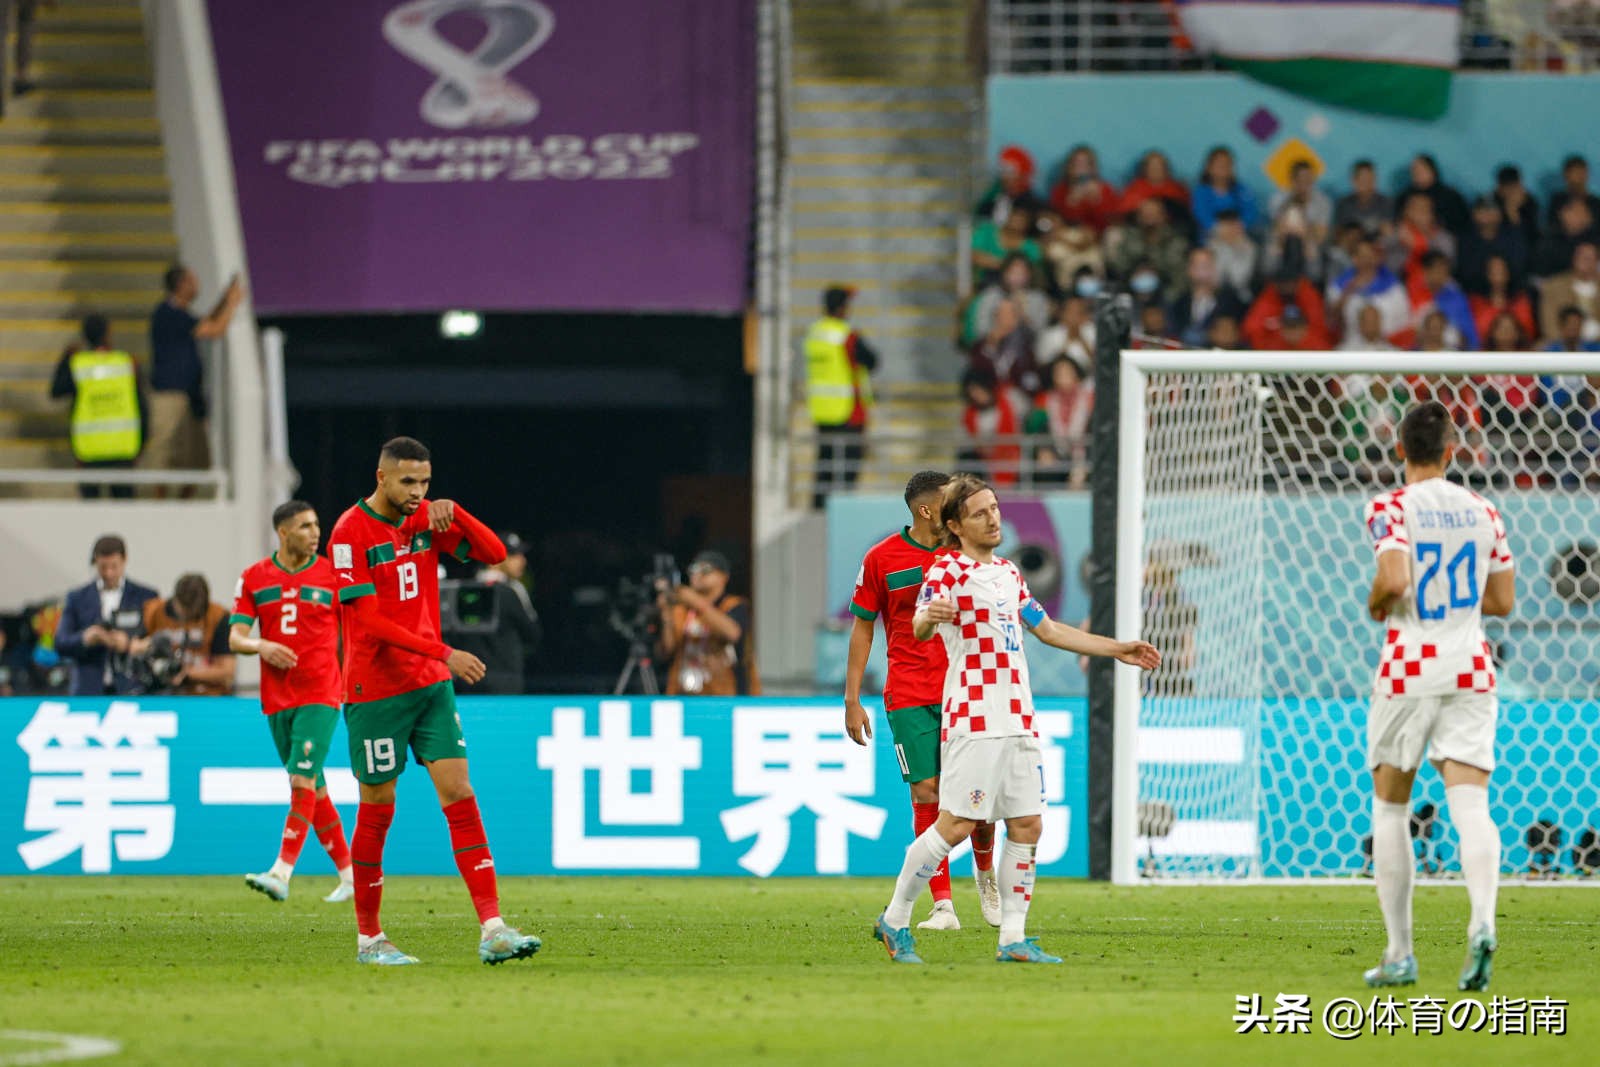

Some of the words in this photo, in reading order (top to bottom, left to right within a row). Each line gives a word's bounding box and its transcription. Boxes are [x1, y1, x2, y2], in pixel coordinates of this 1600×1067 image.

[264, 139, 383, 163] FIFA
[388, 134, 585, 161] WORLD
[592, 132, 699, 156] CUP
[397, 562, 419, 601] 19
[1415, 541, 1479, 620] 20
[280, 603, 297, 635] 2
[1001, 623, 1020, 652] 10
[364, 738, 397, 775] 19
[894, 743, 910, 775] 11
